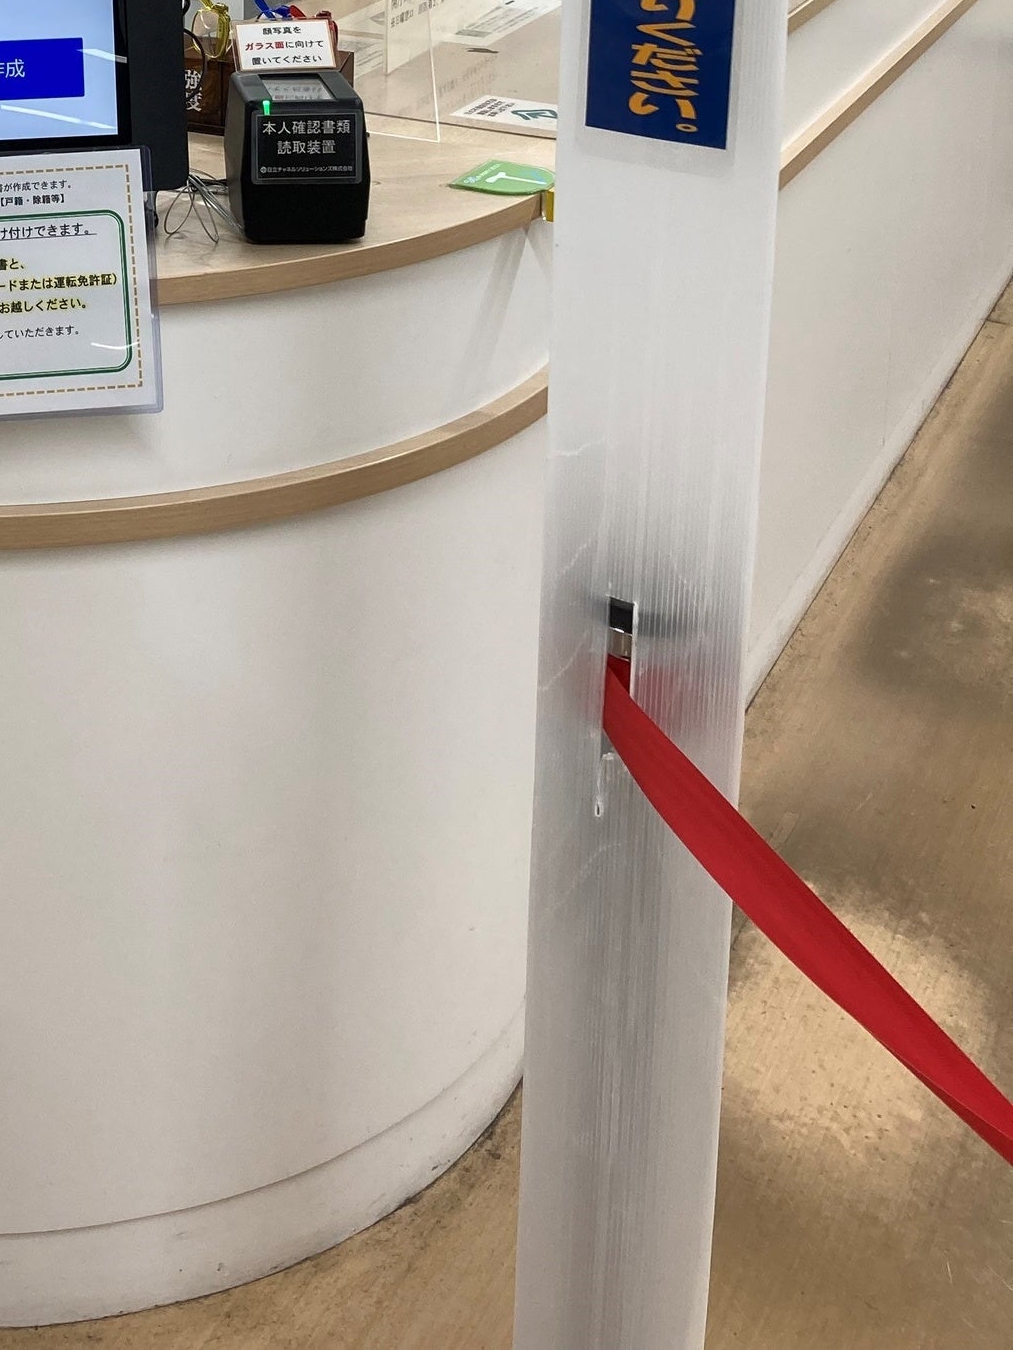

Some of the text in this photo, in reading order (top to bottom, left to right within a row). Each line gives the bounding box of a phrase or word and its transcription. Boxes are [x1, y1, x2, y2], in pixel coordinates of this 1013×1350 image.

[245, 39, 324, 51] ガラス面に向けて
[252, 55, 322, 65] 置いてください
[262, 119, 351, 135] 本人確認書類
[277, 140, 336, 155] 読取装置
